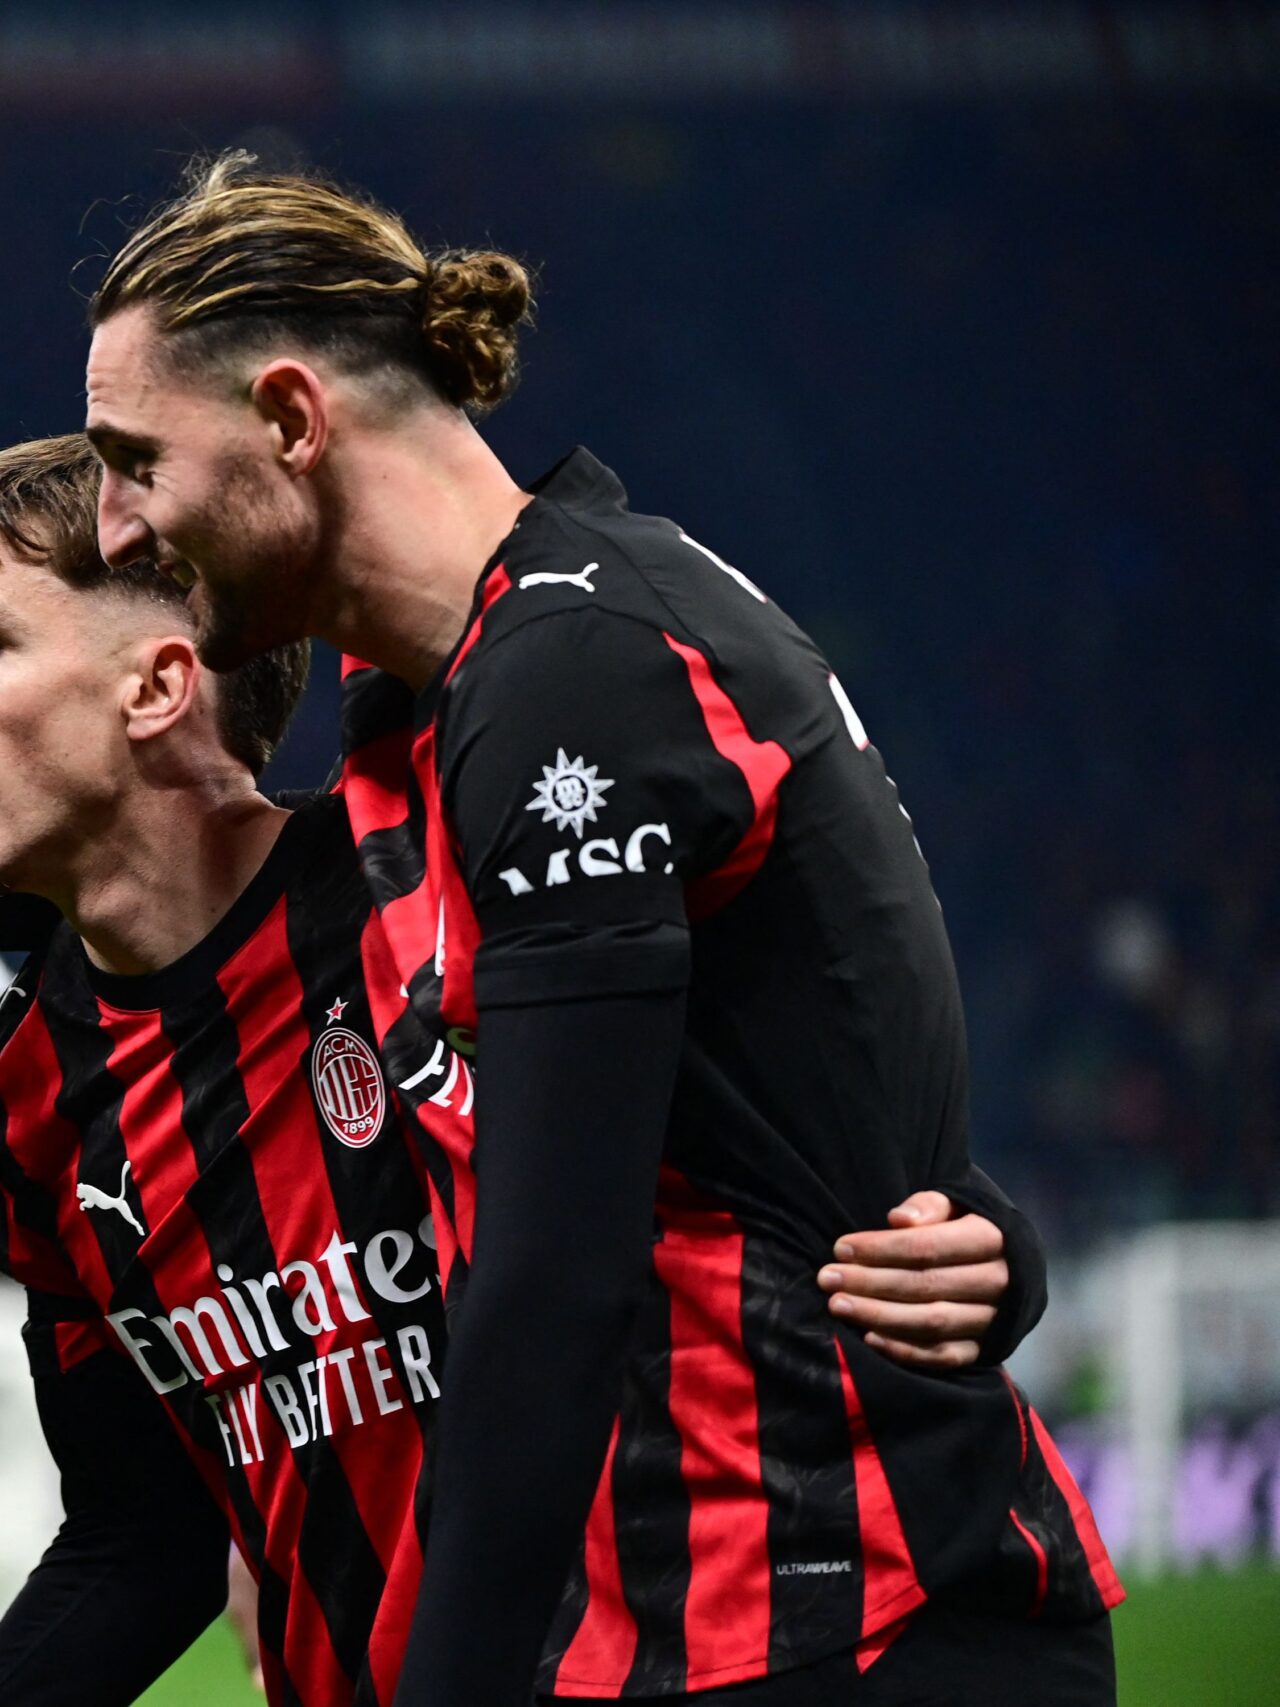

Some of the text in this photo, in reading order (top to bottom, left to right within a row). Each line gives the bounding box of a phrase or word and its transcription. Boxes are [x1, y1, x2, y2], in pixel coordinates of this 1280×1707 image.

[323, 1038, 360, 1064] ACM
[342, 1115, 375, 1134] 1899
[204, 1325, 441, 1467] FLY BETTER
[776, 1560, 852, 1575] ULTRAWEAVE
